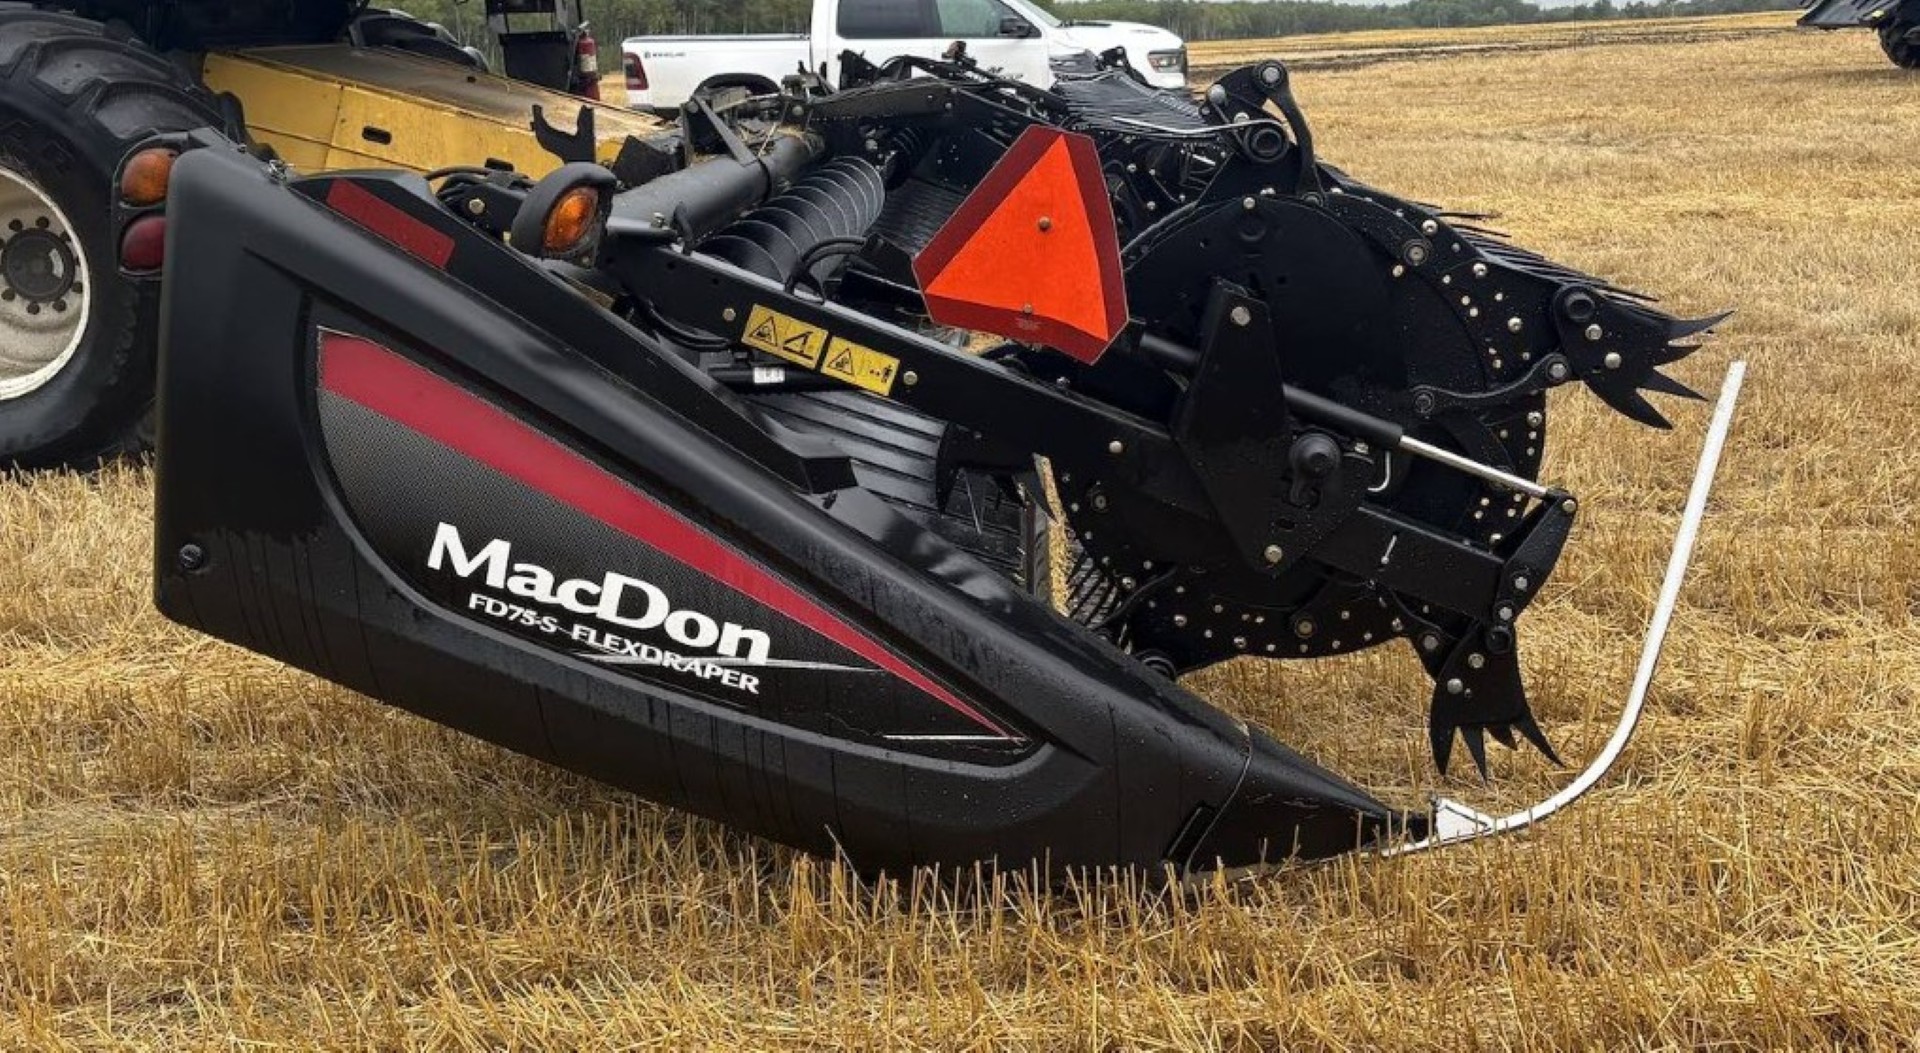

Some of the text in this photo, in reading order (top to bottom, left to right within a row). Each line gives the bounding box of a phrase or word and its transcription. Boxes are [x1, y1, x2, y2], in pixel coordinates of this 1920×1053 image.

[427, 521, 771, 664] MacDon
[468, 592, 760, 694] FD75-S FLEXDRAPER
